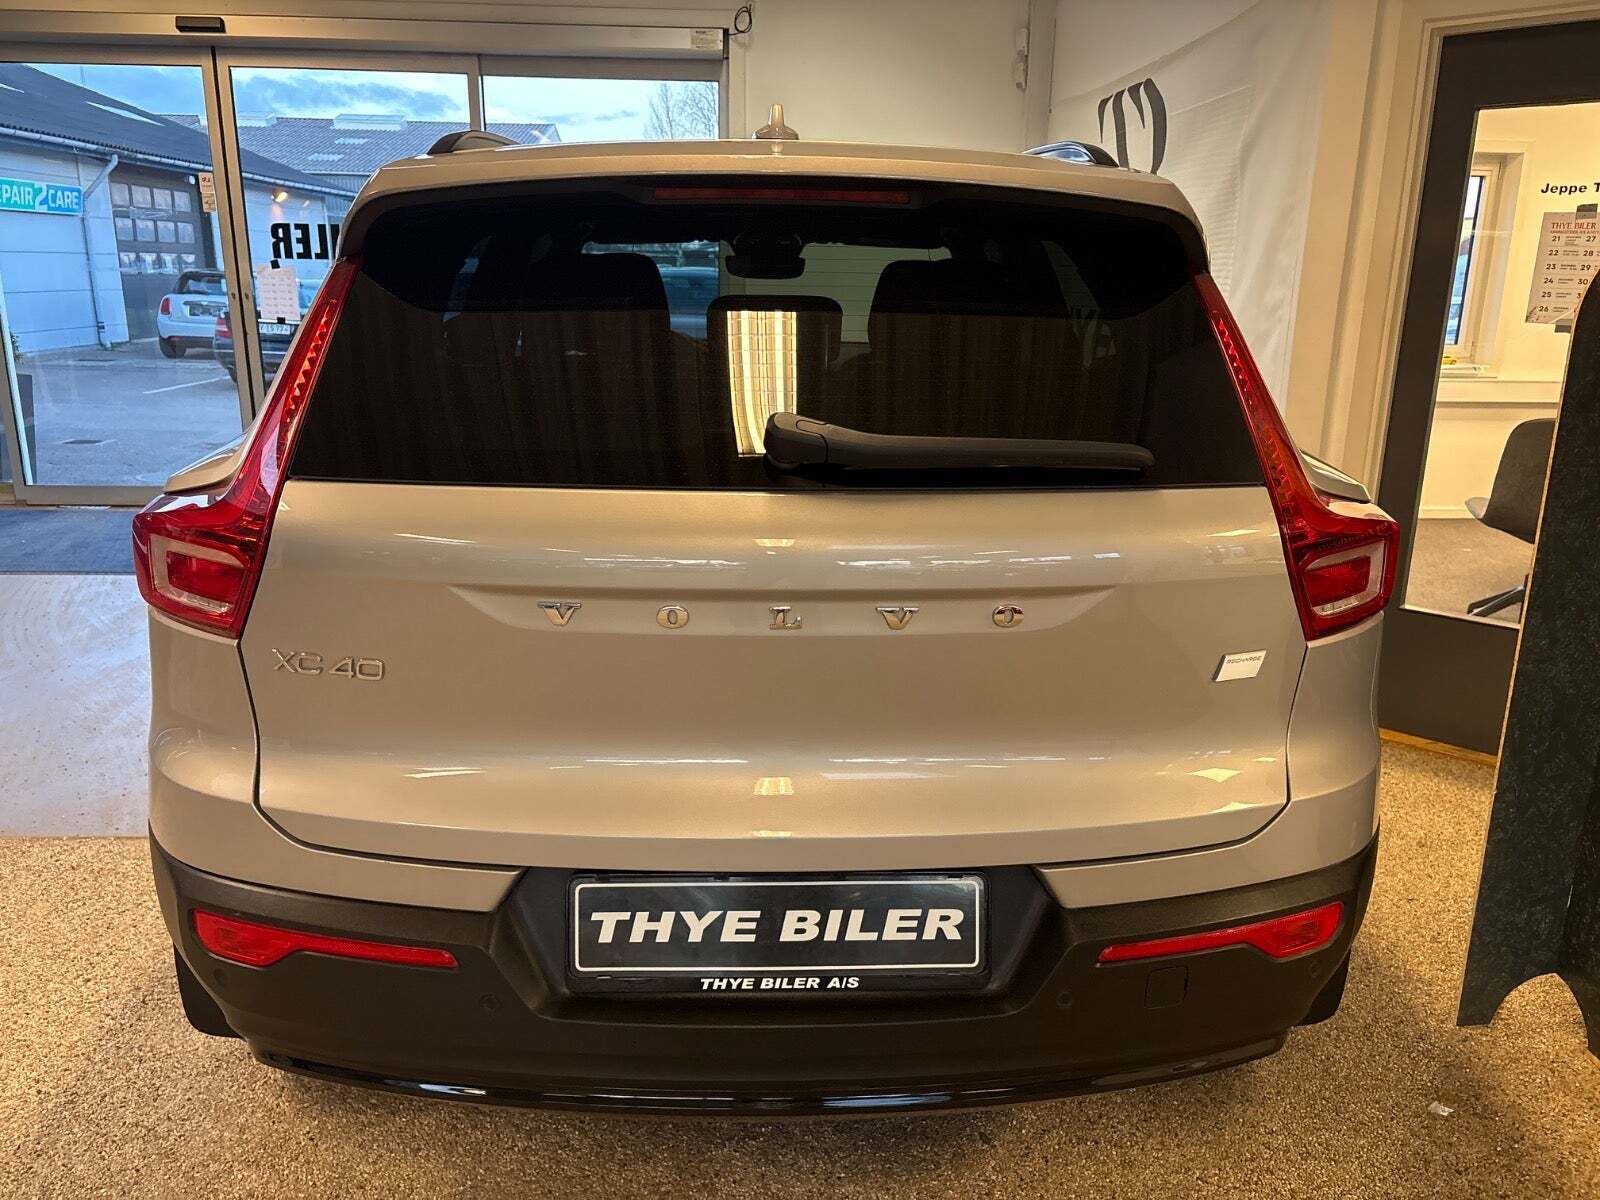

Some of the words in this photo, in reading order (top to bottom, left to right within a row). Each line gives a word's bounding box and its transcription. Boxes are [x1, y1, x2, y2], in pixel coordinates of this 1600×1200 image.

[1541, 183, 1587, 195] Jeppe
[537, 601, 1024, 630] VOLVO
[590, 911, 761, 944] THYE
[779, 908, 964, 943] BILER
[700, 978, 757, 991] THYE
[759, 977, 820, 990] BILER
[826, 976, 860, 990] A/S
